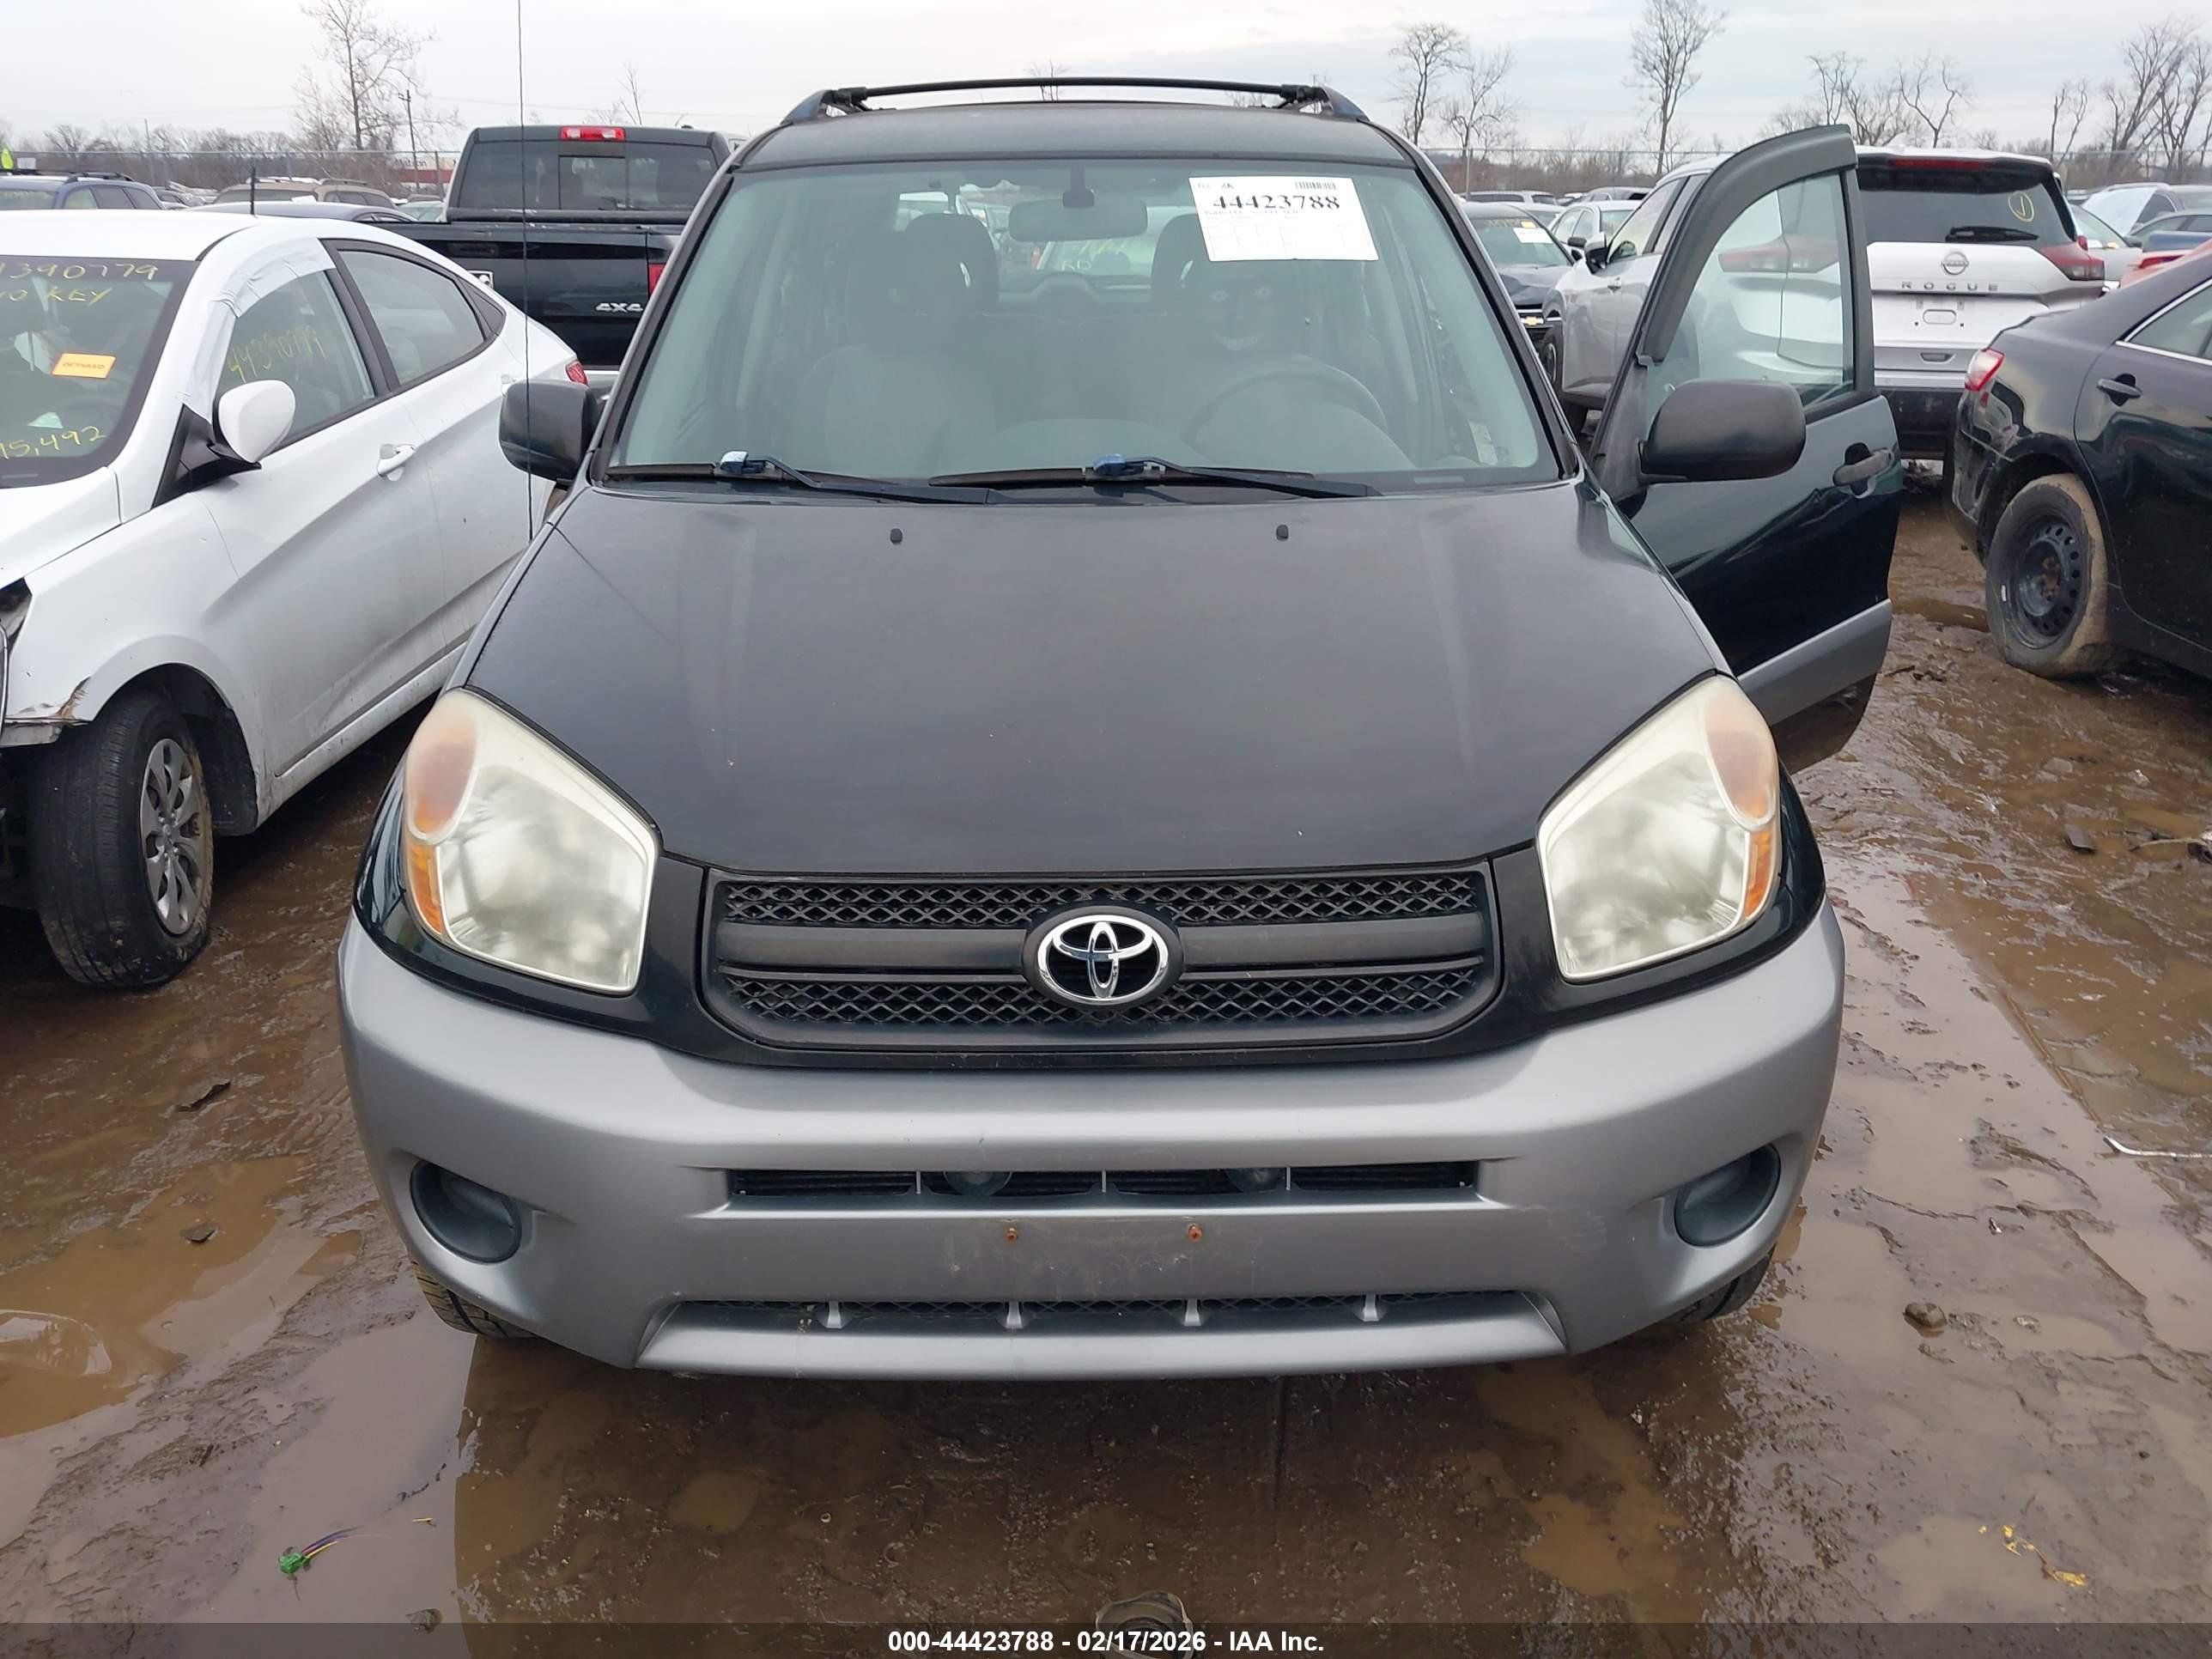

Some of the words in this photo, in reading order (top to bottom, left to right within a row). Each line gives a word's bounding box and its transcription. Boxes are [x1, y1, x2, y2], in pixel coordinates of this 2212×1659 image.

[1212, 194, 1340, 210] 44423788
[0, 263, 159, 281] 390779
[1901, 281, 1999, 292] ROGUE
[46, 285, 113, 307] KEY
